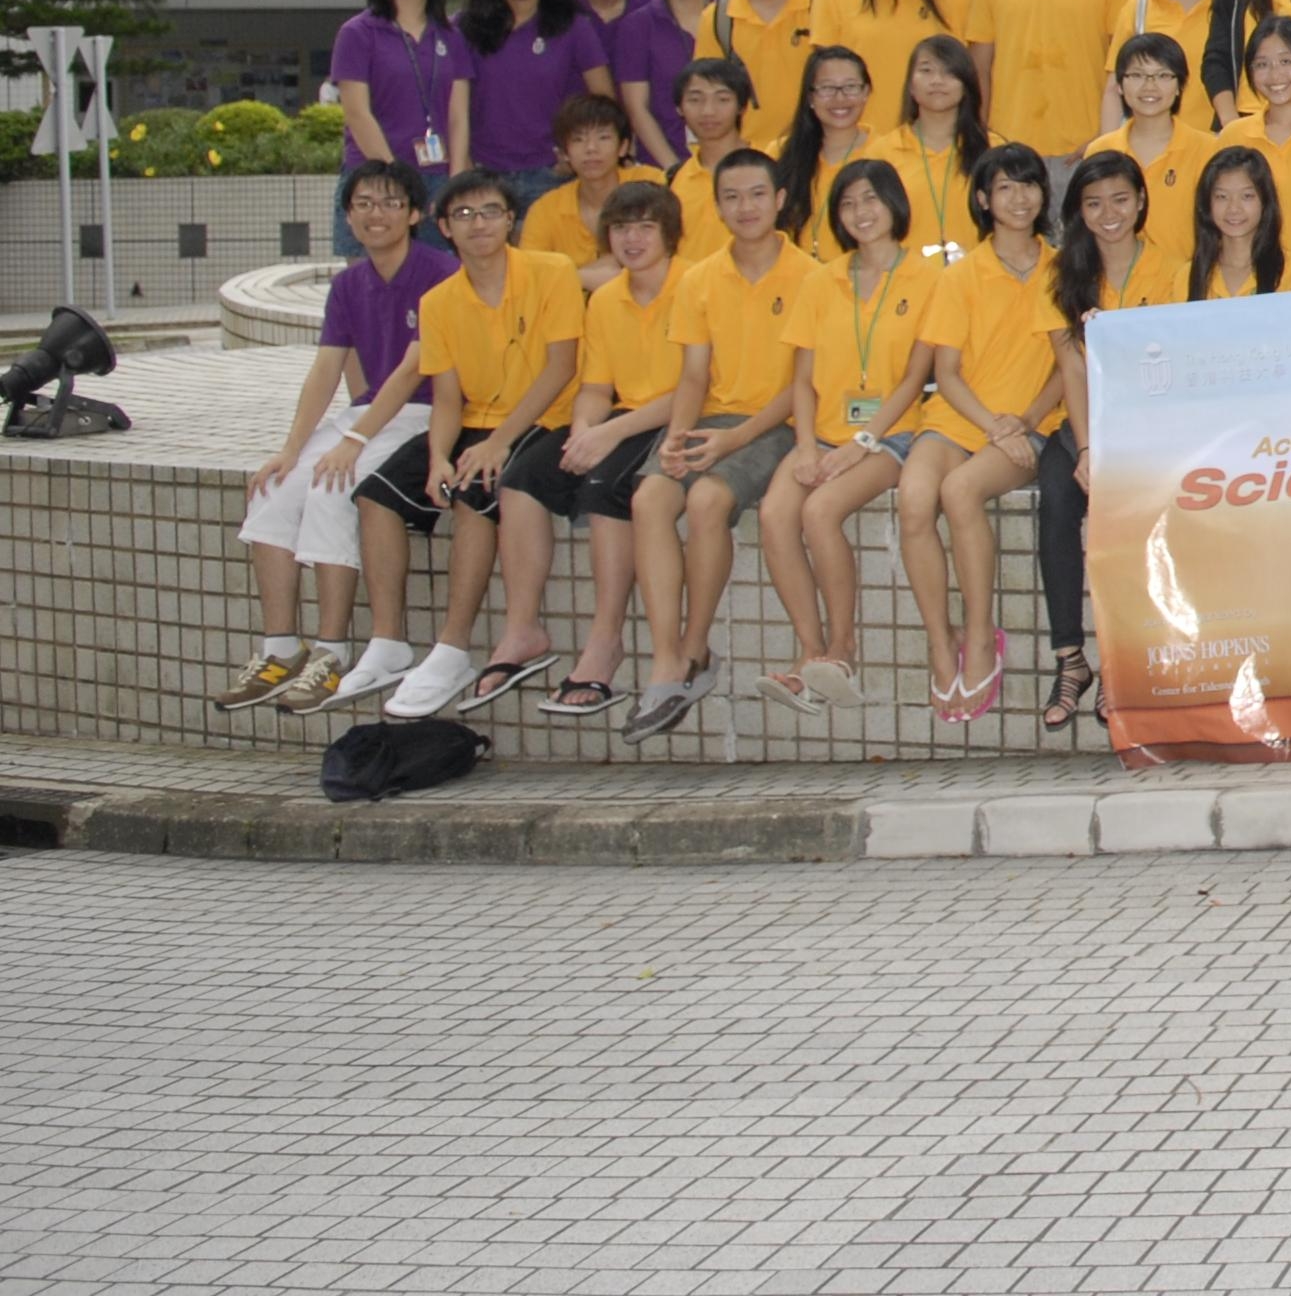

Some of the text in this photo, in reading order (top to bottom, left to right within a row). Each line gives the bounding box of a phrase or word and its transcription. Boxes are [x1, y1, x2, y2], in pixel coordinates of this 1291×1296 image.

[1147, 644, 1197, 667] JOHNS
[1200, 635, 1271, 659] HOPKINS
[1183, 683, 1197, 694] for
